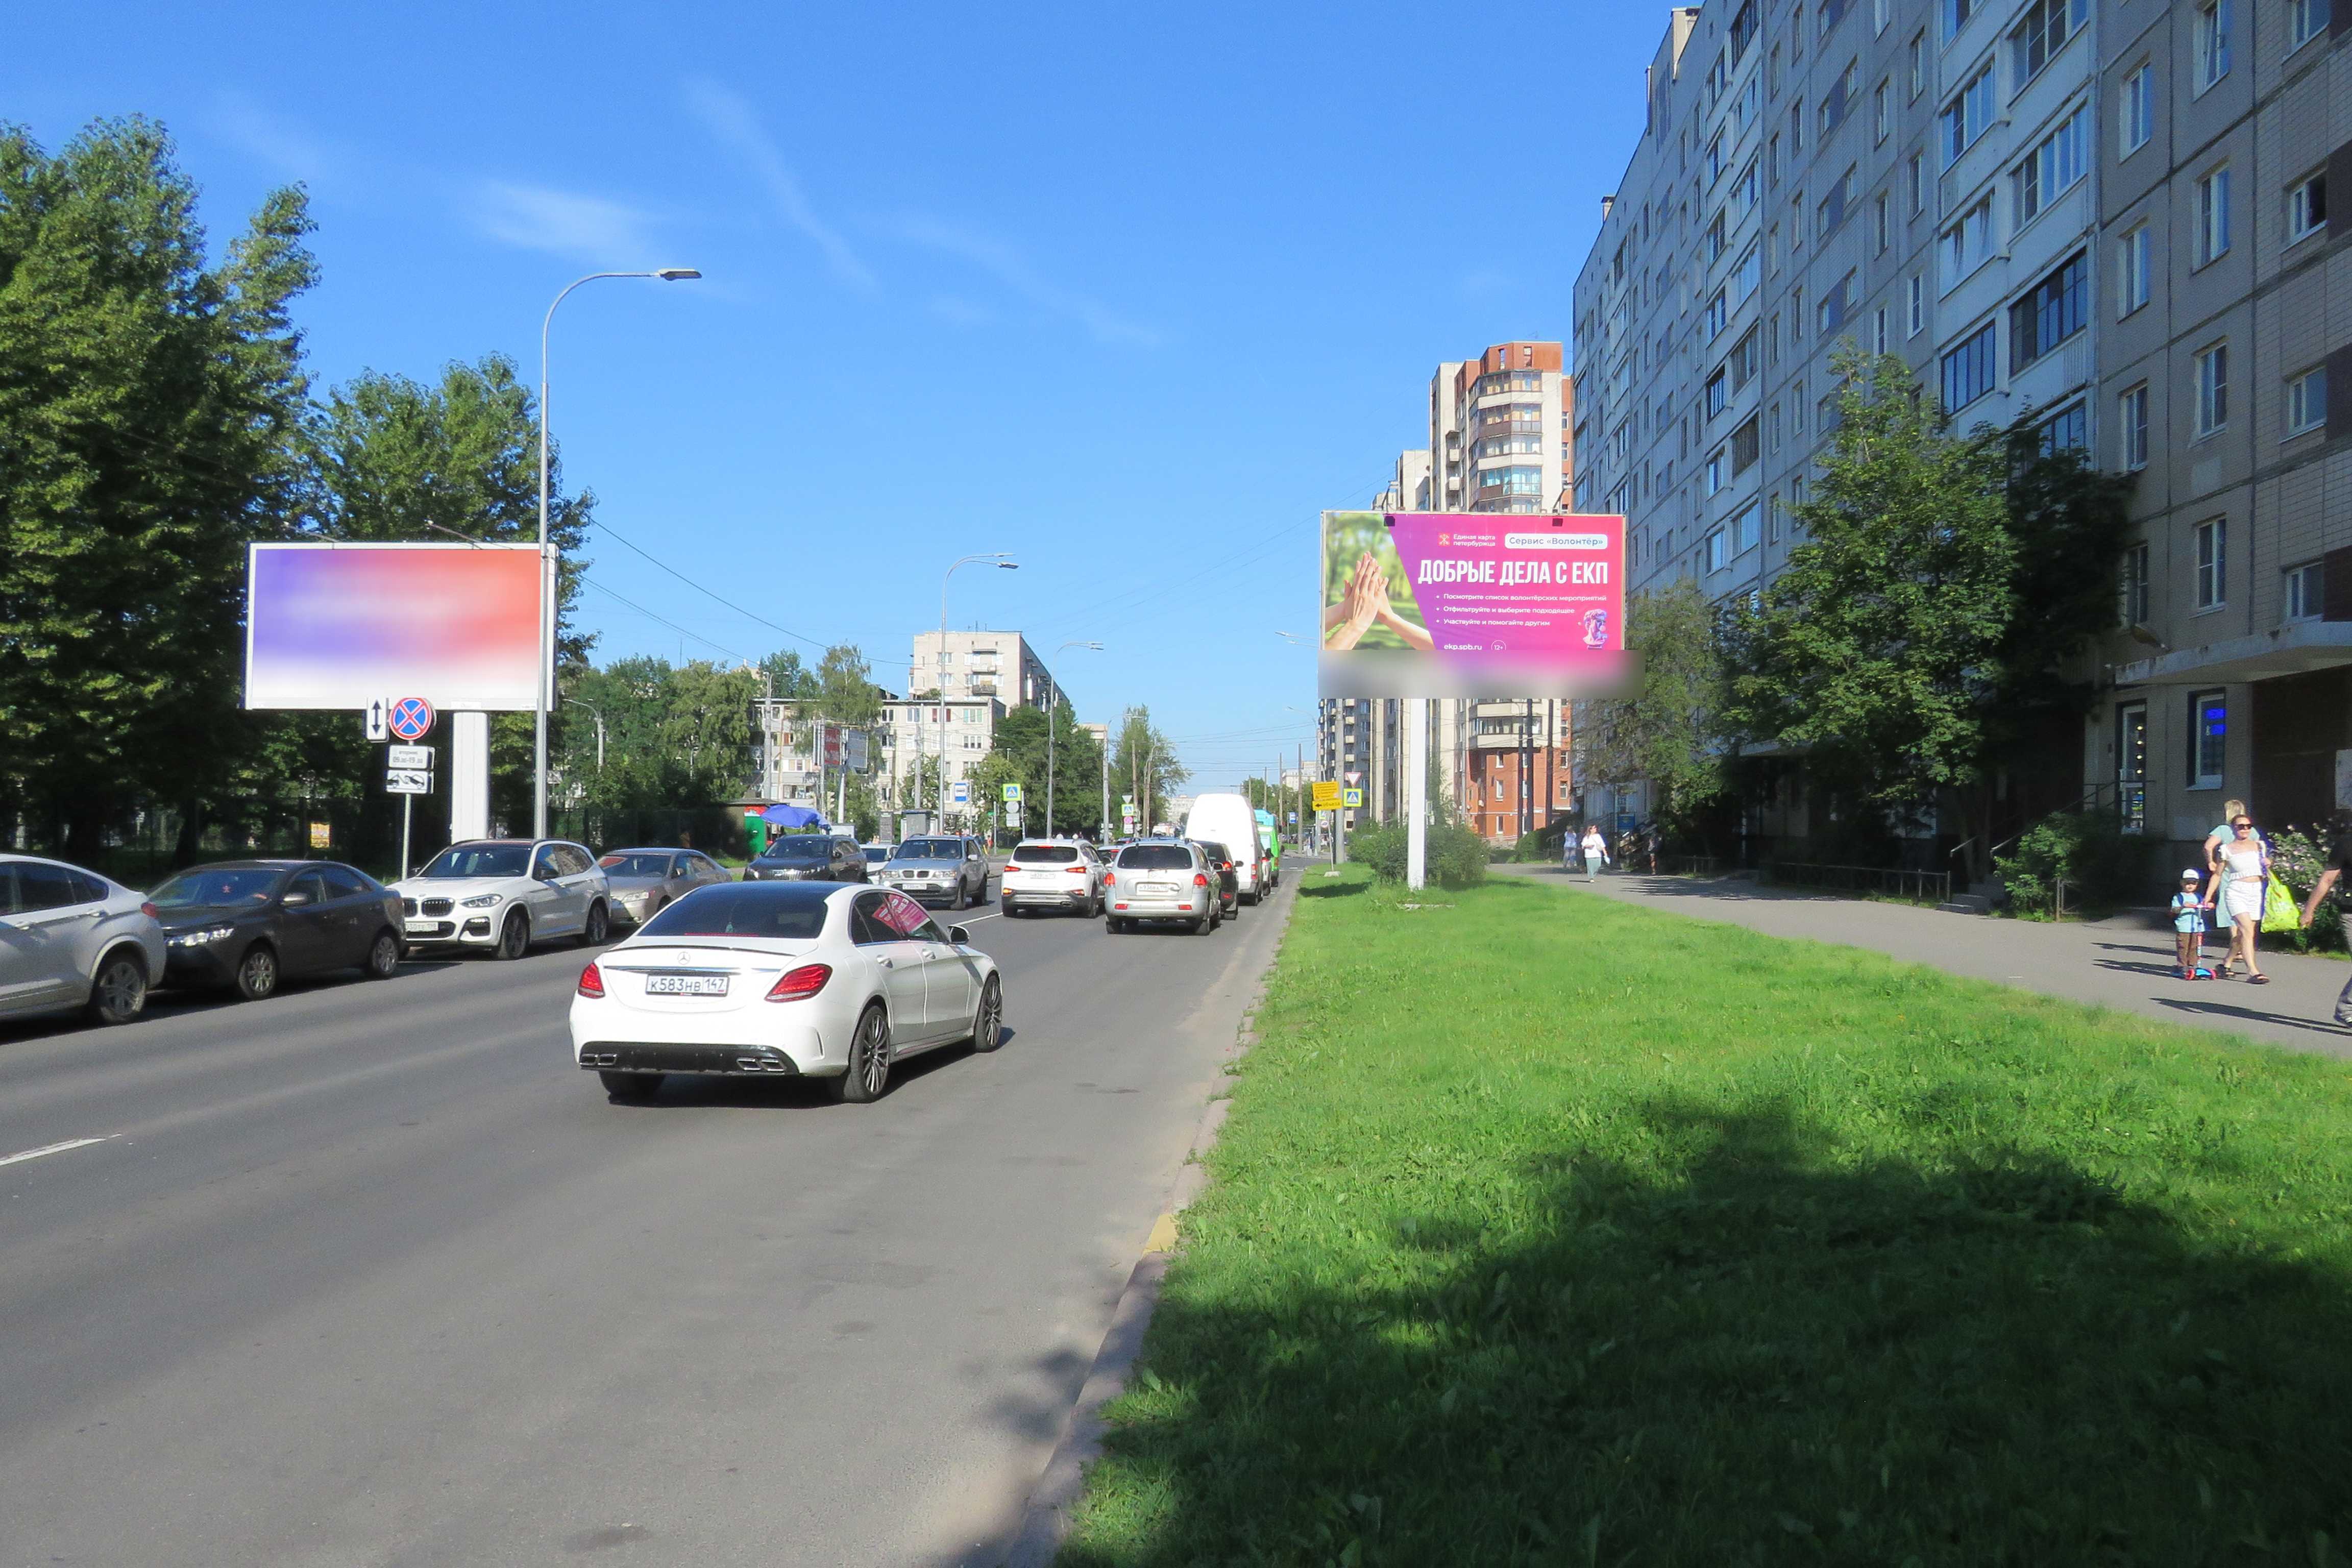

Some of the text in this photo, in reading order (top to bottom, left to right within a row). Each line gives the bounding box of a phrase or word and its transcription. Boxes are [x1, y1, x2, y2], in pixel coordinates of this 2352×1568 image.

[1509, 537, 1603, 546] Сервис «Волонтёр»
[1418, 559, 1608, 585] ДОБРЫЕ ДЕЛА С ЕКП
[1443, 606, 1490, 614] Отфильтруйте
[705, 978, 724, 990] 147
